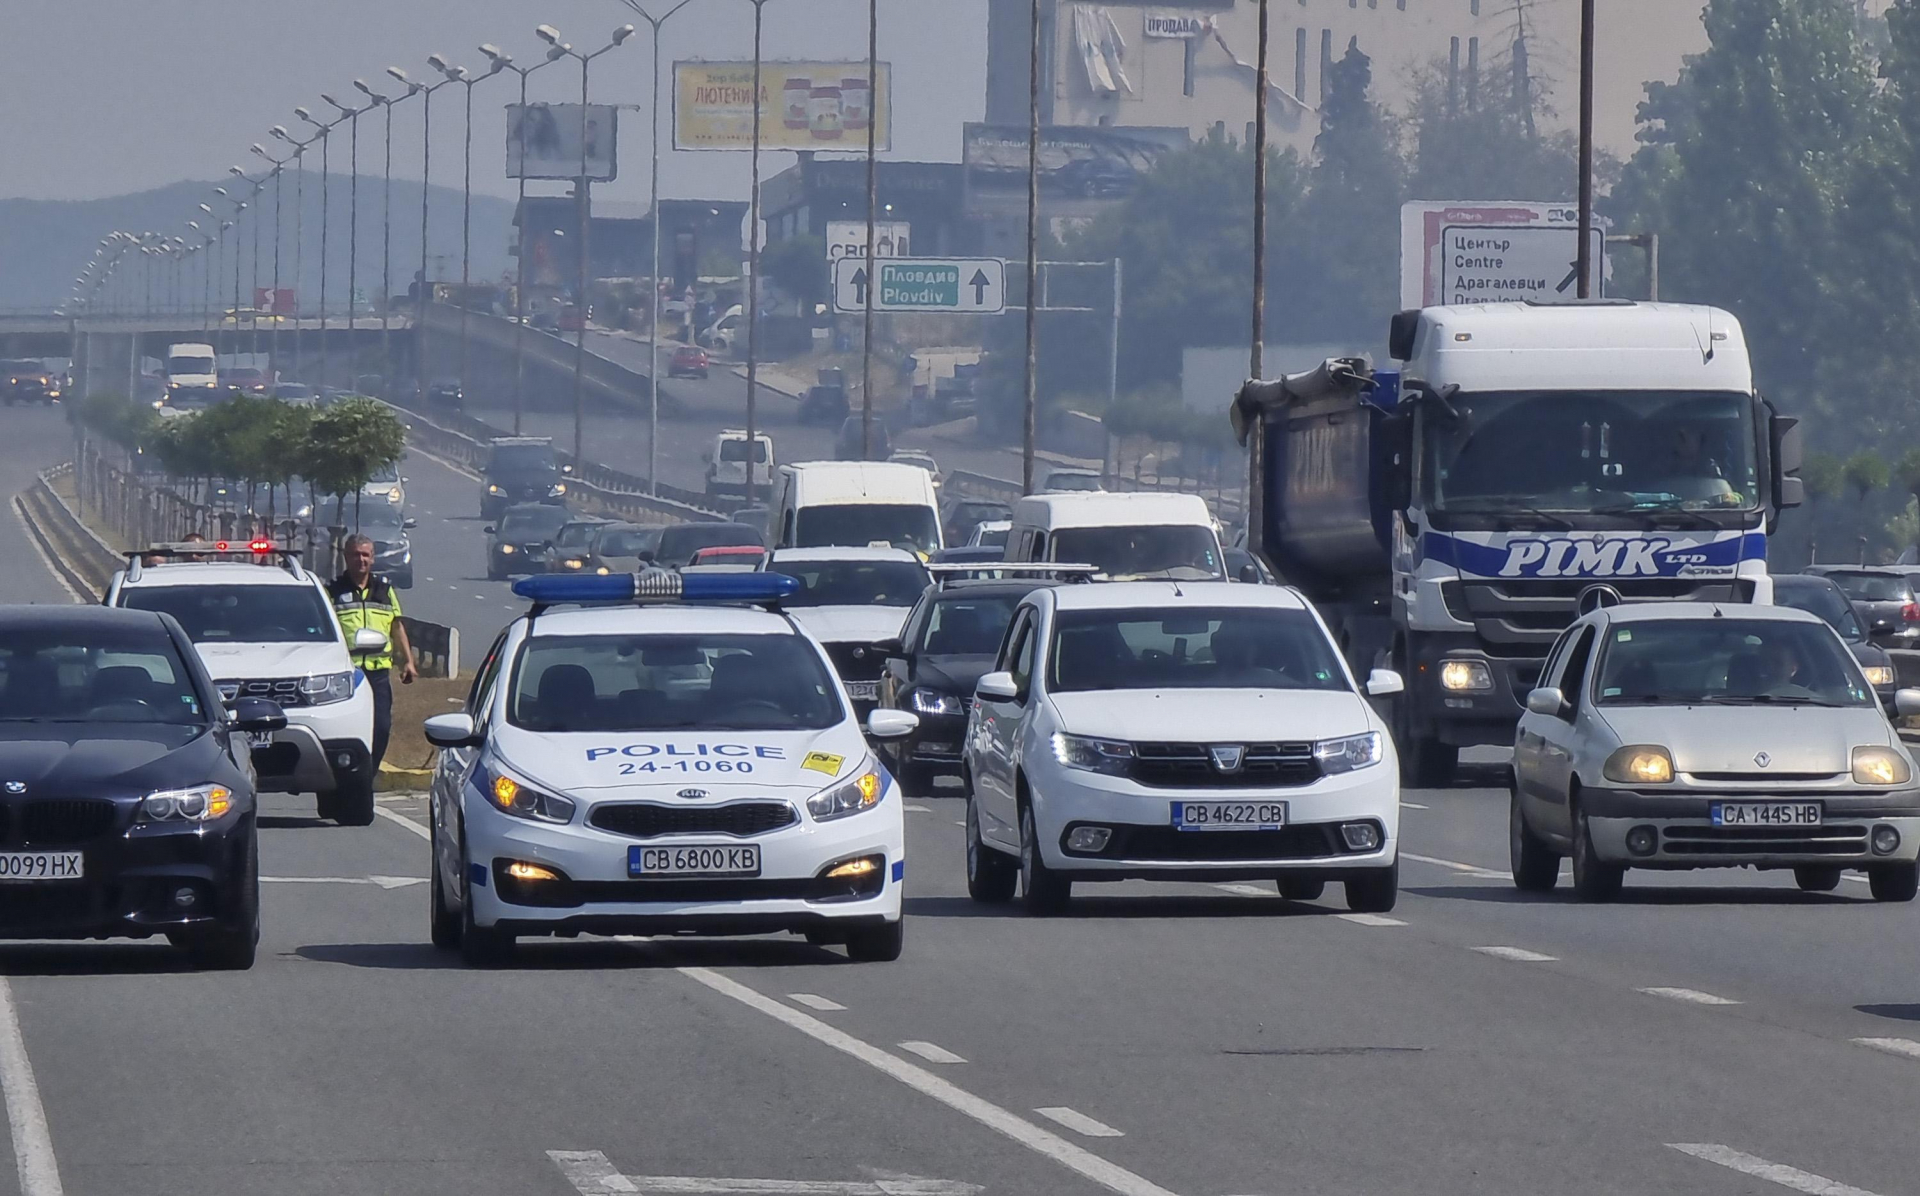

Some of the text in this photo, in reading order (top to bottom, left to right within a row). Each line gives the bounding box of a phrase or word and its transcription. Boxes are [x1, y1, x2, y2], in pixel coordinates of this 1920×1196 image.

[1454, 236, 1511, 252] Център
[1454, 254, 1504, 268] Centre
[884, 267, 957, 284] Пловдив
[1454, 275, 1547, 290] Драгалевци
[884, 287, 944, 303] Plovdiv
[1498, 539, 1707, 577] PIMK LTD
[585, 743, 787, 761] POLICE
[617, 760, 754, 776] 24-1060
[1185, 805, 1282, 823] CB 4622 CB
[1724, 805, 1819, 824] CA 1445 HB
[52, 855, 79, 875] HX
[643, 849, 756, 870] CB 6800 KB
